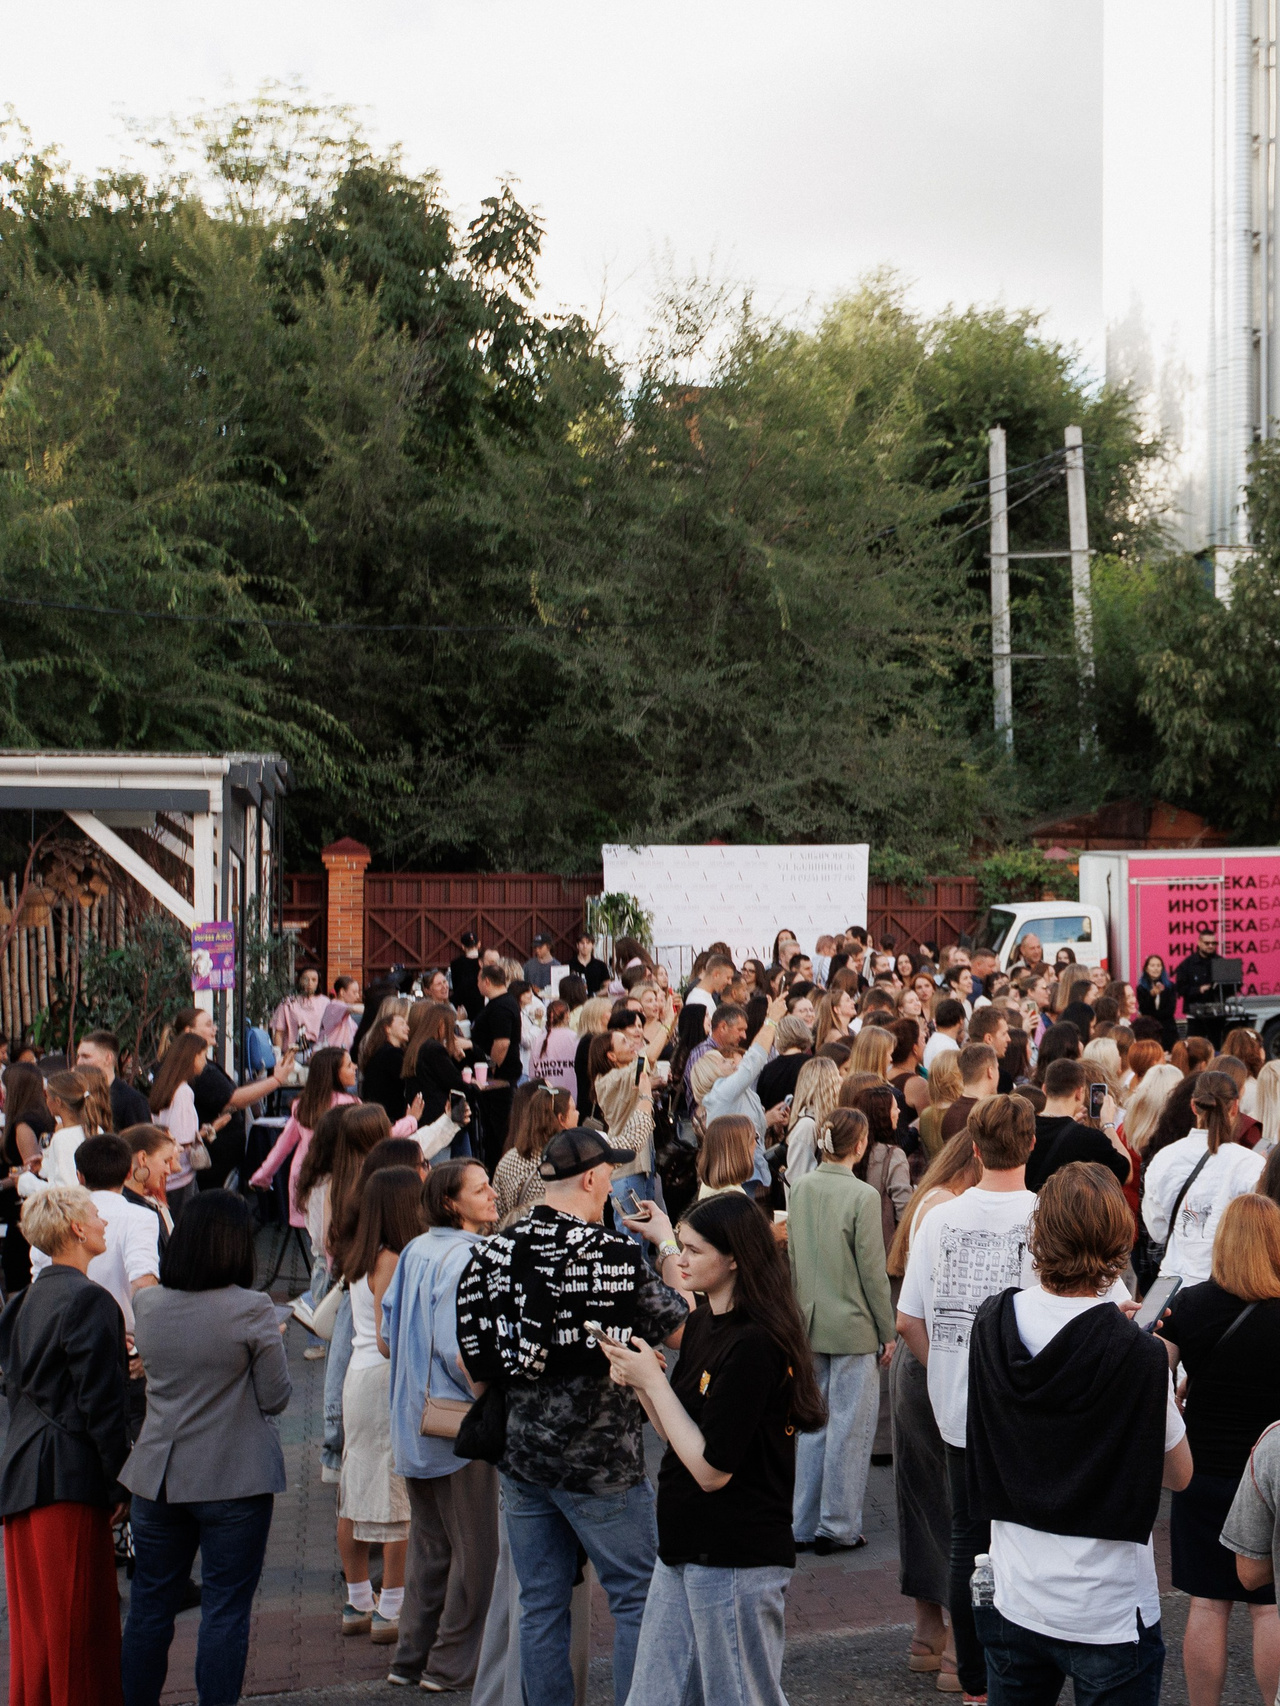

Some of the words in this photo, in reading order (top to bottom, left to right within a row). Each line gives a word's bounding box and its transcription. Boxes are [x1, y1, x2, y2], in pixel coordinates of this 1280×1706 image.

[534, 1069, 563, 1079] QUEEN
[564, 1264, 588, 1277] alm
[592, 1262, 635, 1277] Angels
[592, 1278, 635, 1293] Angels
